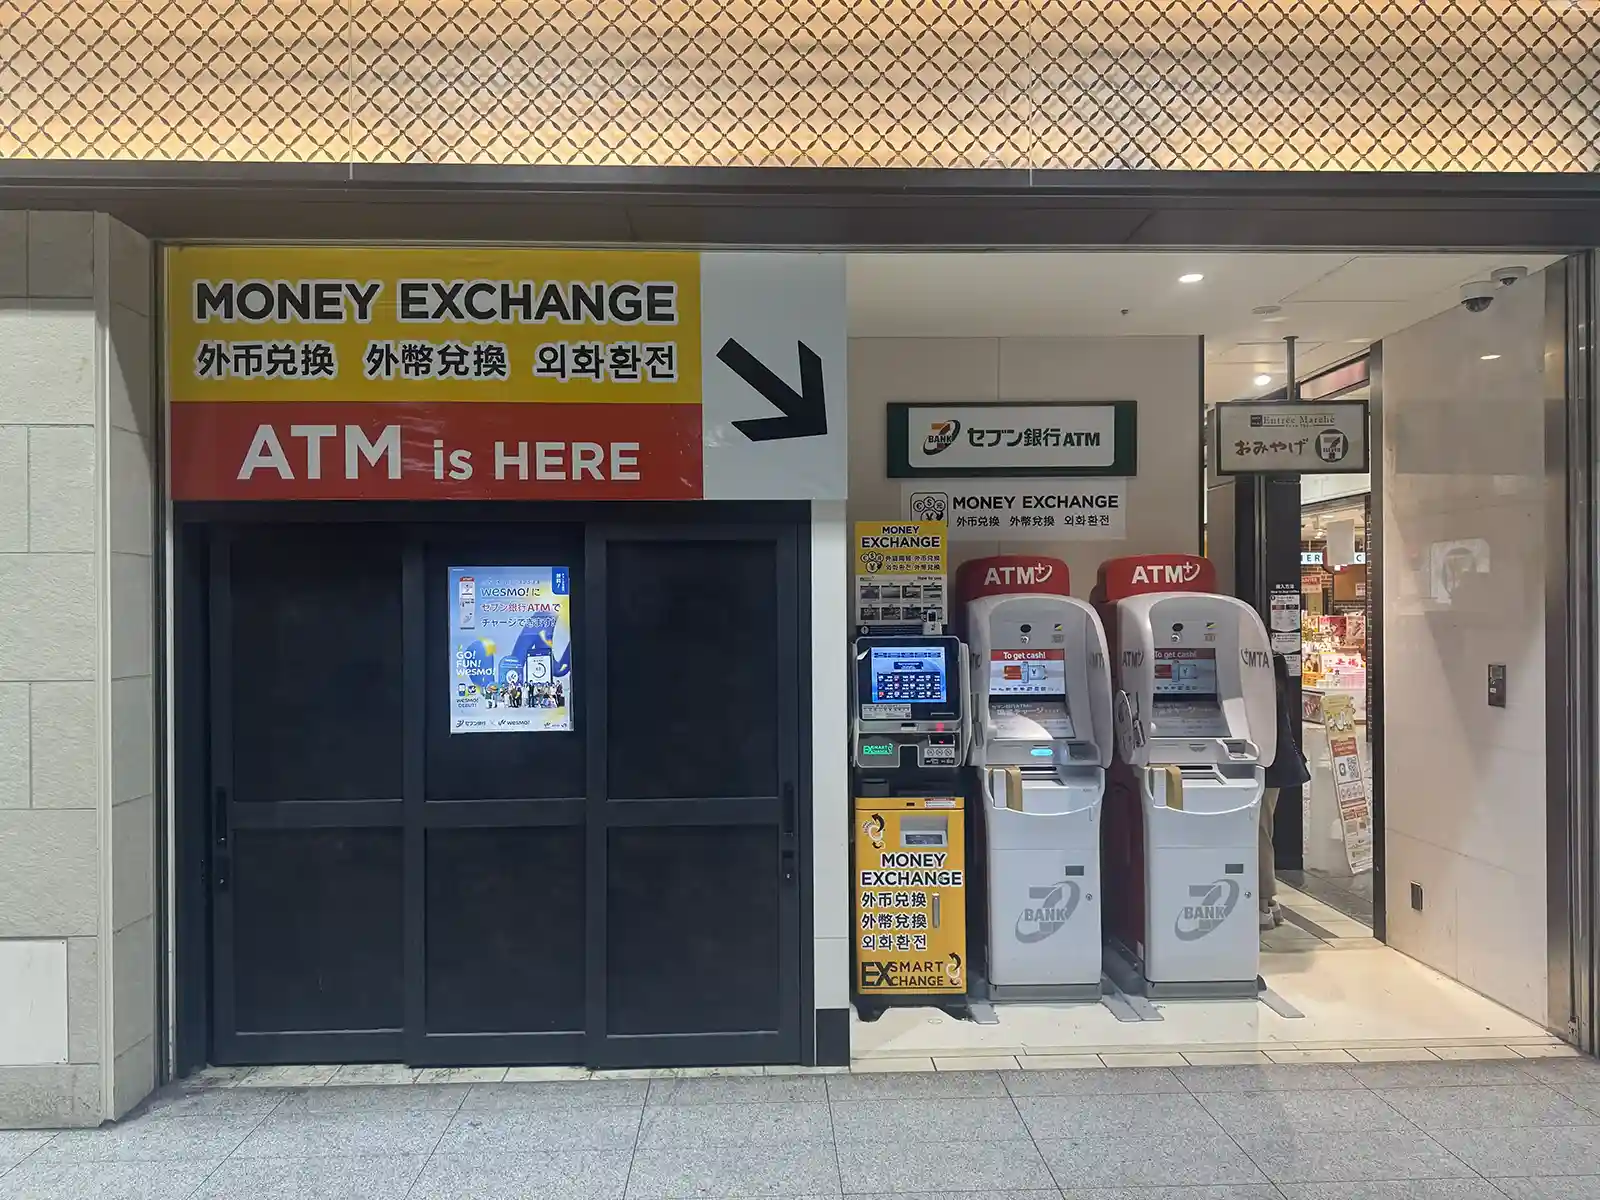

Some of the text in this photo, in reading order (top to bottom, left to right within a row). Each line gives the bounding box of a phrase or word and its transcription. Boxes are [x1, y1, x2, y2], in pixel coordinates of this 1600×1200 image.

[195, 282, 677, 324] MONEY EXCHANGE
[197, 343, 335, 378] 外币兑换
[536, 343, 677, 380] 외화환전
[928, 435, 952, 443] BANK
[237, 424, 642, 482] ATM is HERE
[1234, 437, 1309, 456] おみやげ
[952, 495, 1119, 510] MONEY EXCHANGE
[1064, 514, 1110, 526] 외화환전
[882, 526, 920, 534] MONEY
[861, 536, 941, 549] EXCHANGE
[456, 651, 476, 660] GO!
[1013, 652, 1025, 660] get
[1164, 651, 1176, 660] get
[881, 853, 946, 867] MONEY
[861, 871, 962, 886] EXCHANGE
[861, 892, 927, 908] 外币兑换
[1024, 908, 1067, 922] BANK
[1183, 906, 1226, 920] BANK
[862, 935, 927, 950] 외화환전
[890, 961, 944, 973] SMART
